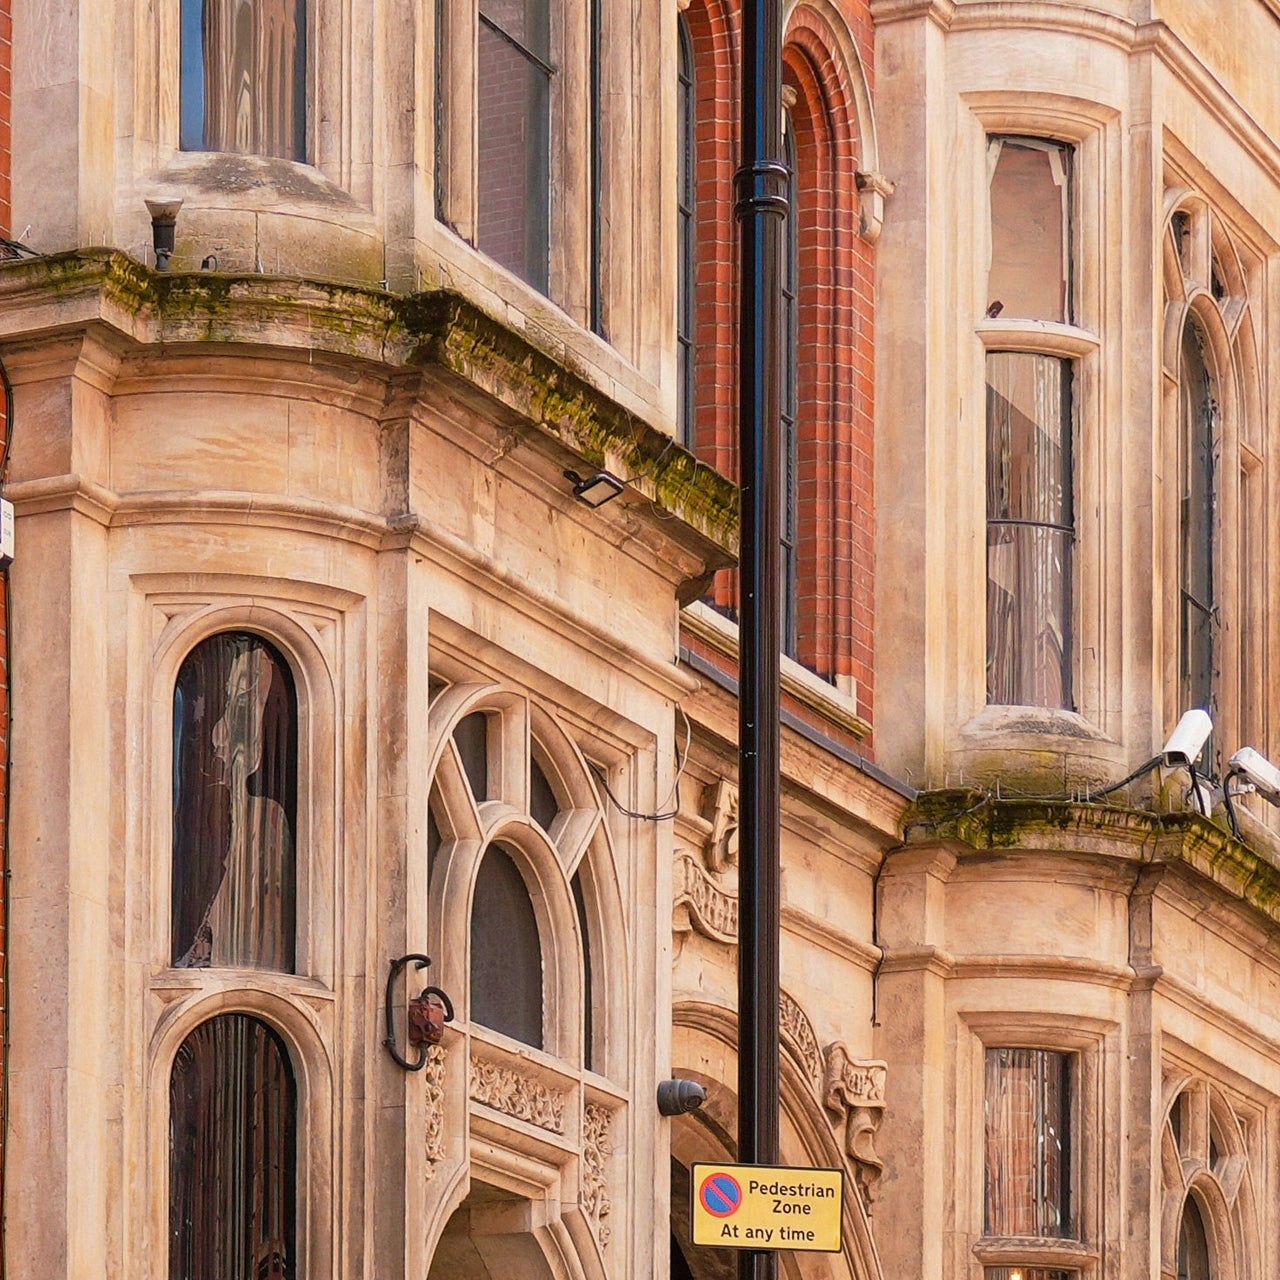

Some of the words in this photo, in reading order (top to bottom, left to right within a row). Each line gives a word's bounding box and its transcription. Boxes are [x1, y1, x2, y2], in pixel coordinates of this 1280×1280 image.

[749, 1180, 835, 1198] Pedestrian
[772, 1199, 811, 1215] Zone
[721, 1223, 739, 1238] At
[745, 1227, 774, 1242] any
[779, 1226, 815, 1241] time
